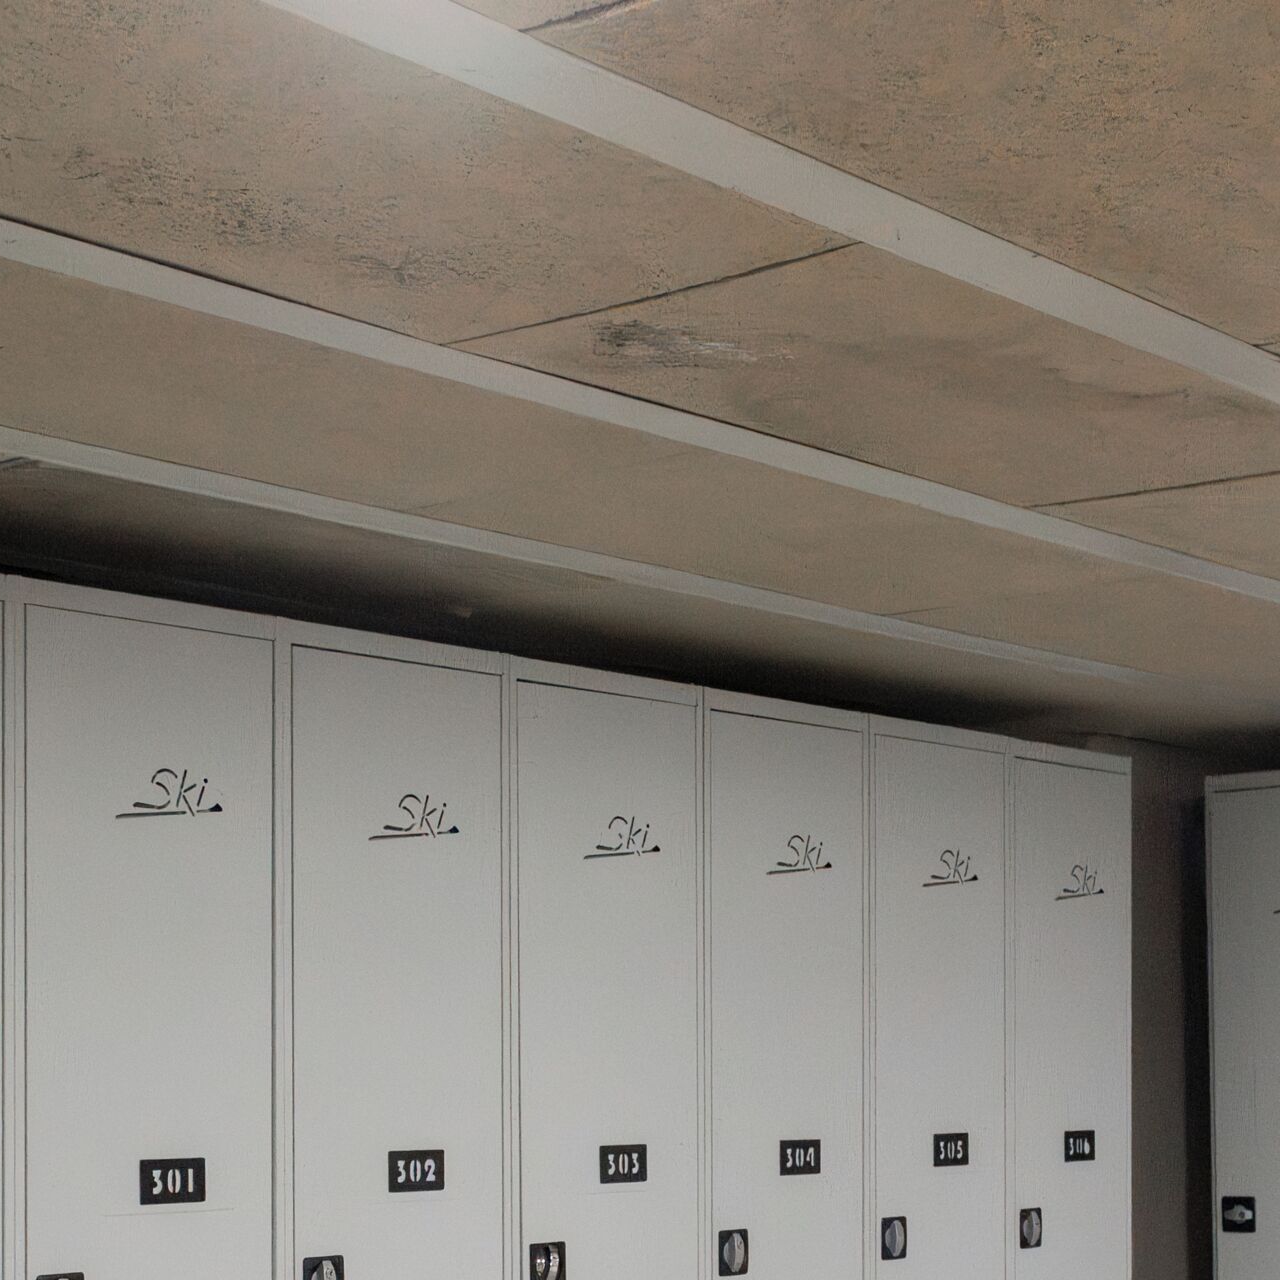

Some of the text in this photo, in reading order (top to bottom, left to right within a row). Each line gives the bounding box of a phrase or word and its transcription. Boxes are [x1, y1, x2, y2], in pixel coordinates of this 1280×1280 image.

[131, 768, 222, 816] Ski
[381, 793, 458, 838] Ski
[594, 815, 660, 857] Ski
[774, 834, 831, 873] Ski
[929, 849, 977, 885] Ski
[1061, 864, 1103, 898] Ski
[786, 1146, 815, 1168] 304
[939, 1140, 963, 1160] 305
[1069, 1137, 1091, 1156] 306
[397, 1158, 436, 1184] 302
[607, 1152, 640, 1176] 303
[152, 1168, 194, 1195] 301
